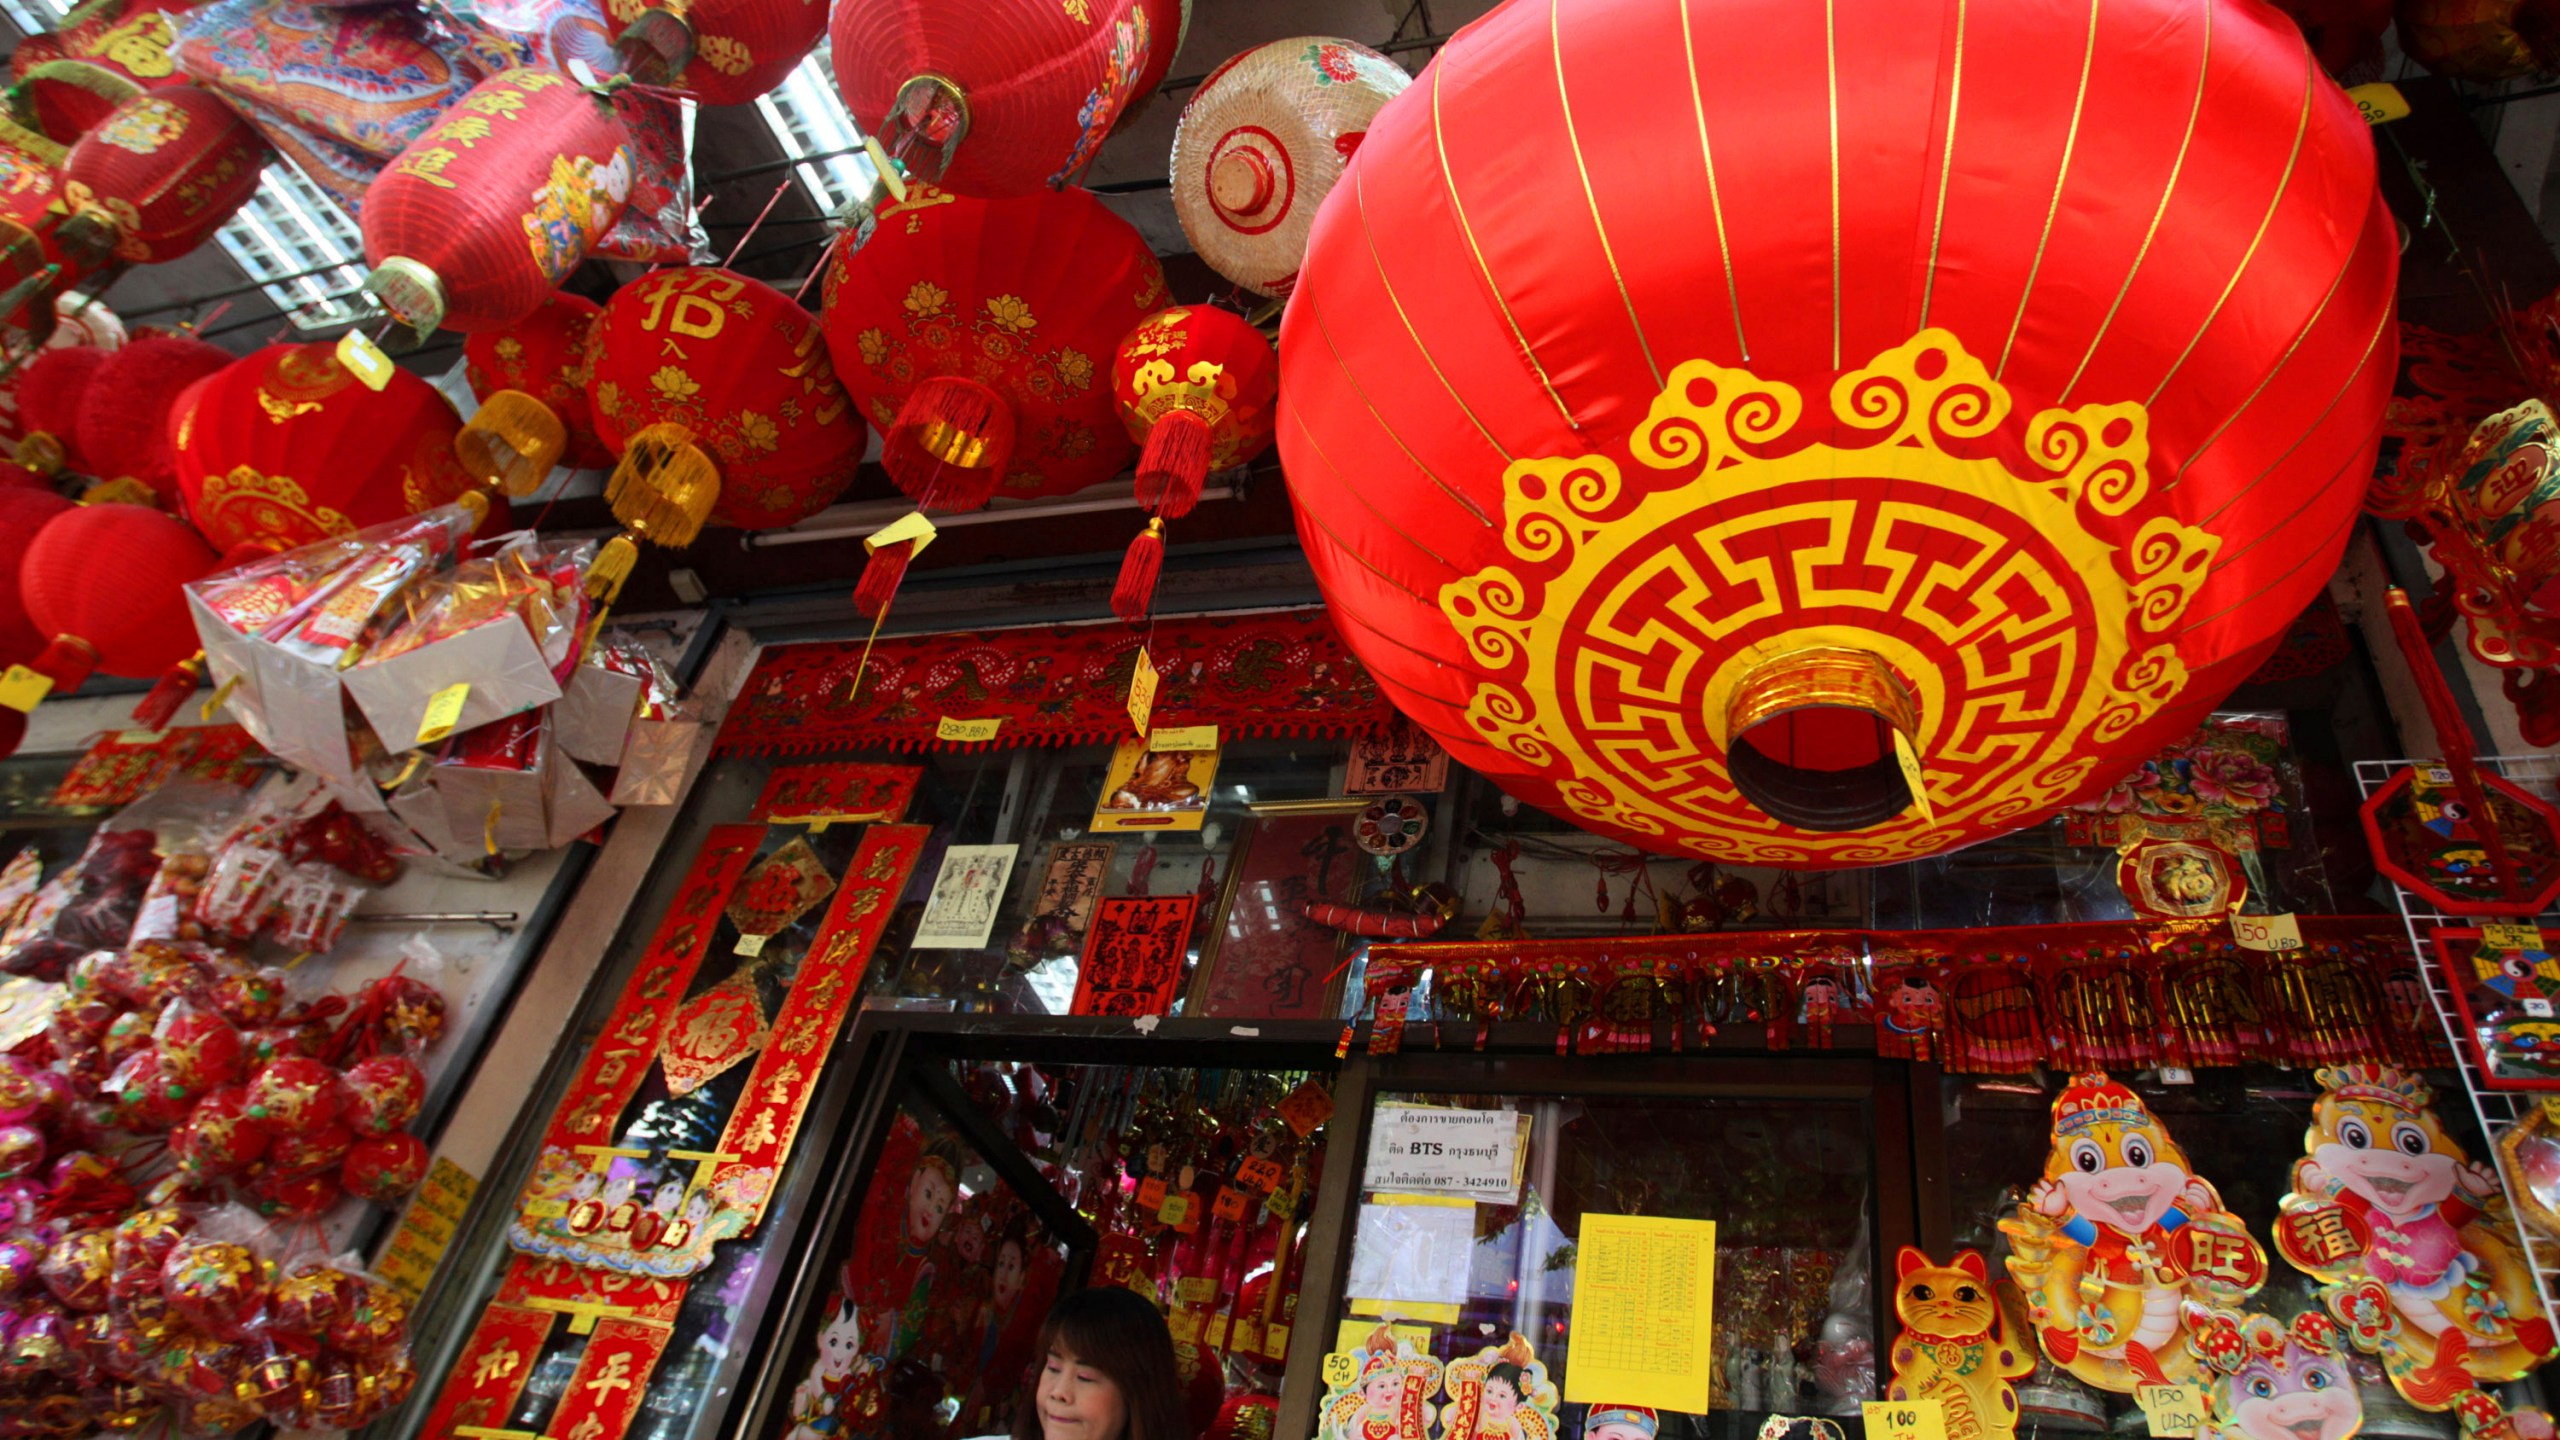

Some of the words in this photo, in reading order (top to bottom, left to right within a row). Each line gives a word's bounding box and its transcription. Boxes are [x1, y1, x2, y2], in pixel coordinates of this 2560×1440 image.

[640, 270, 746, 340] 招
[2234, 920, 2268, 941] 150
[2268, 937, 2298, 950] UBD
[1400, 1111, 1494, 1125] ต้องการขายคอนโด
[1389, 1143, 1404, 1155] ติด
[1410, 1141, 1443, 1156] BTS
[1449, 1144, 1499, 1161] กรุงธนบุรี
[1374, 1171, 1431, 1186] สนใจติดต่อ
[1434, 1175, 1453, 1186] 087
[1463, 1176, 1508, 1188] 3424910
[2296, 1206, 2348, 1262] 福
[2191, 1231, 2251, 1281] 旺
[1328, 1356, 1350, 1370] 50
[1333, 1372, 1350, 1382] CH
[2149, 1387, 2184, 1409] 150
[1886, 1409, 1917, 1430] 100
